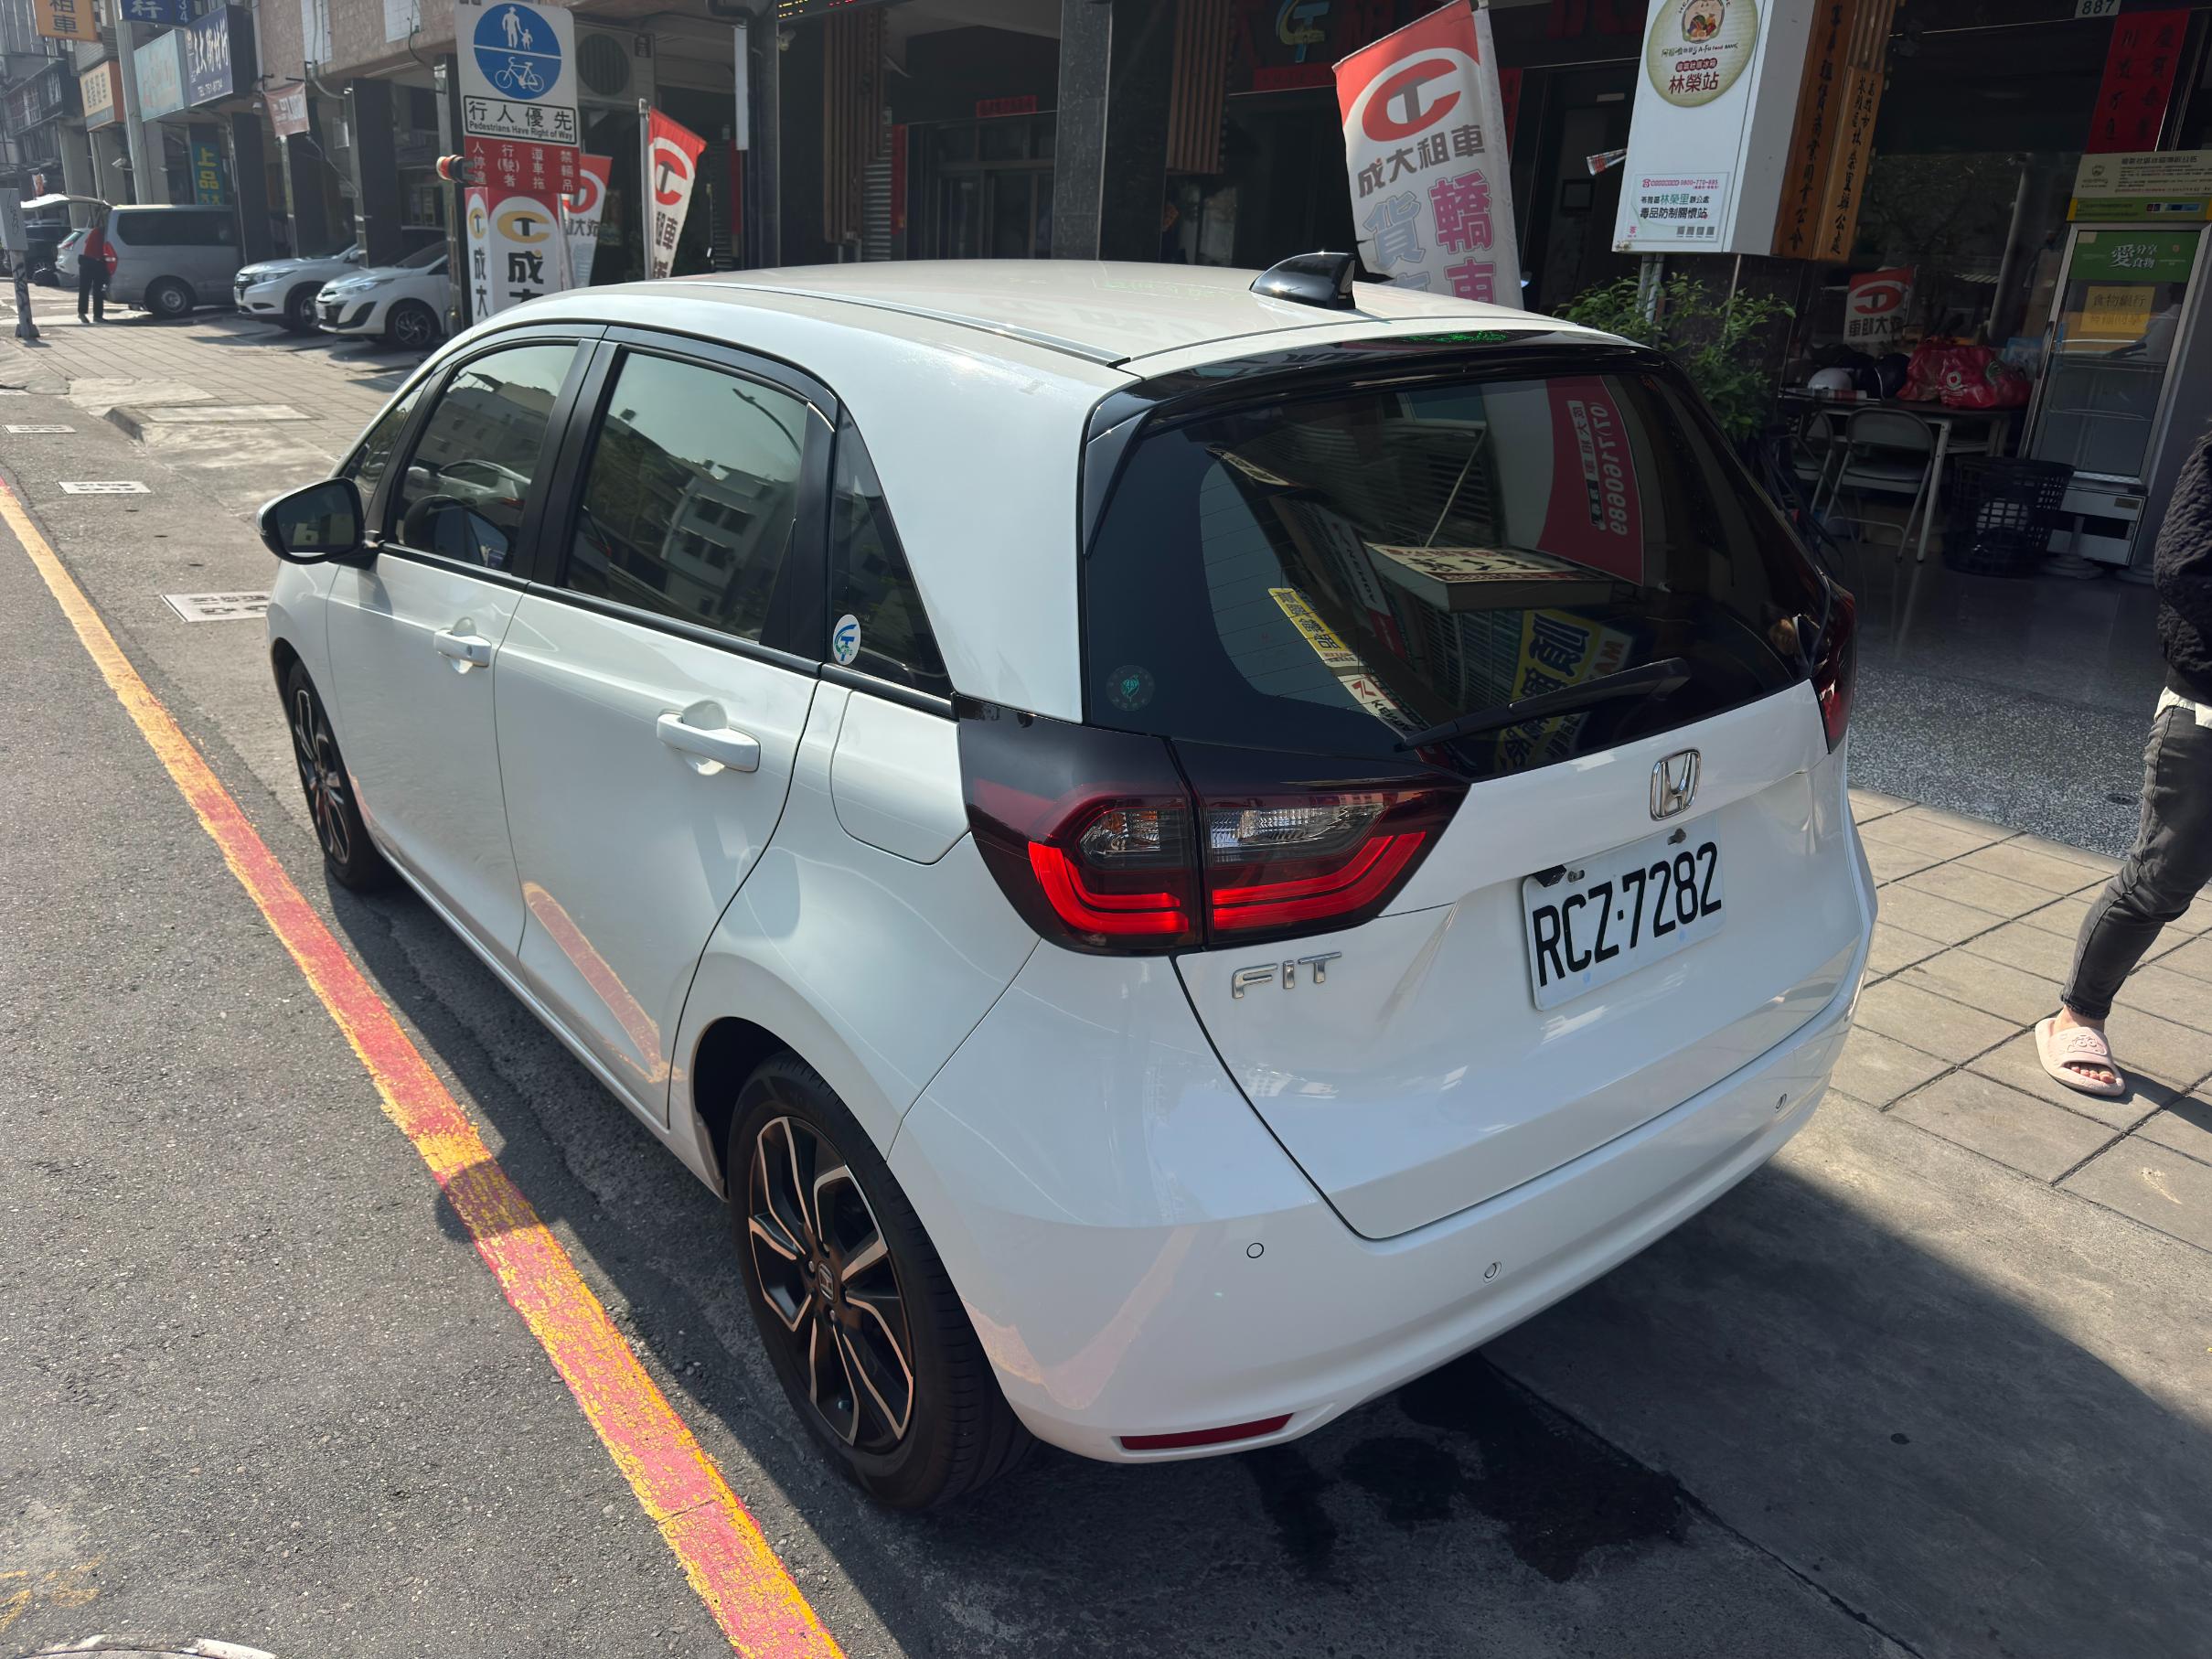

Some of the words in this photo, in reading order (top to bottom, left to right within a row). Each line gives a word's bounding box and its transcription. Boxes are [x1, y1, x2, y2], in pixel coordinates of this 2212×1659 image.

[2081, 0, 2113, 16] 887
[1668, 71, 1720, 95] 林榮站
[468, 101, 572, 131] 行人優先
[469, 120, 510, 134] Pedestrians
[512, 126, 529, 134] Have
[530, 127, 549, 139] Right
[558, 132, 572, 141] Way
[1357, 124, 1486, 198] 成大租車
[1640, 207, 1709, 219] 毒品防制關懷站
[2108, 243, 2136, 271] 愛
[1230, 951, 1343, 1000] FIT
